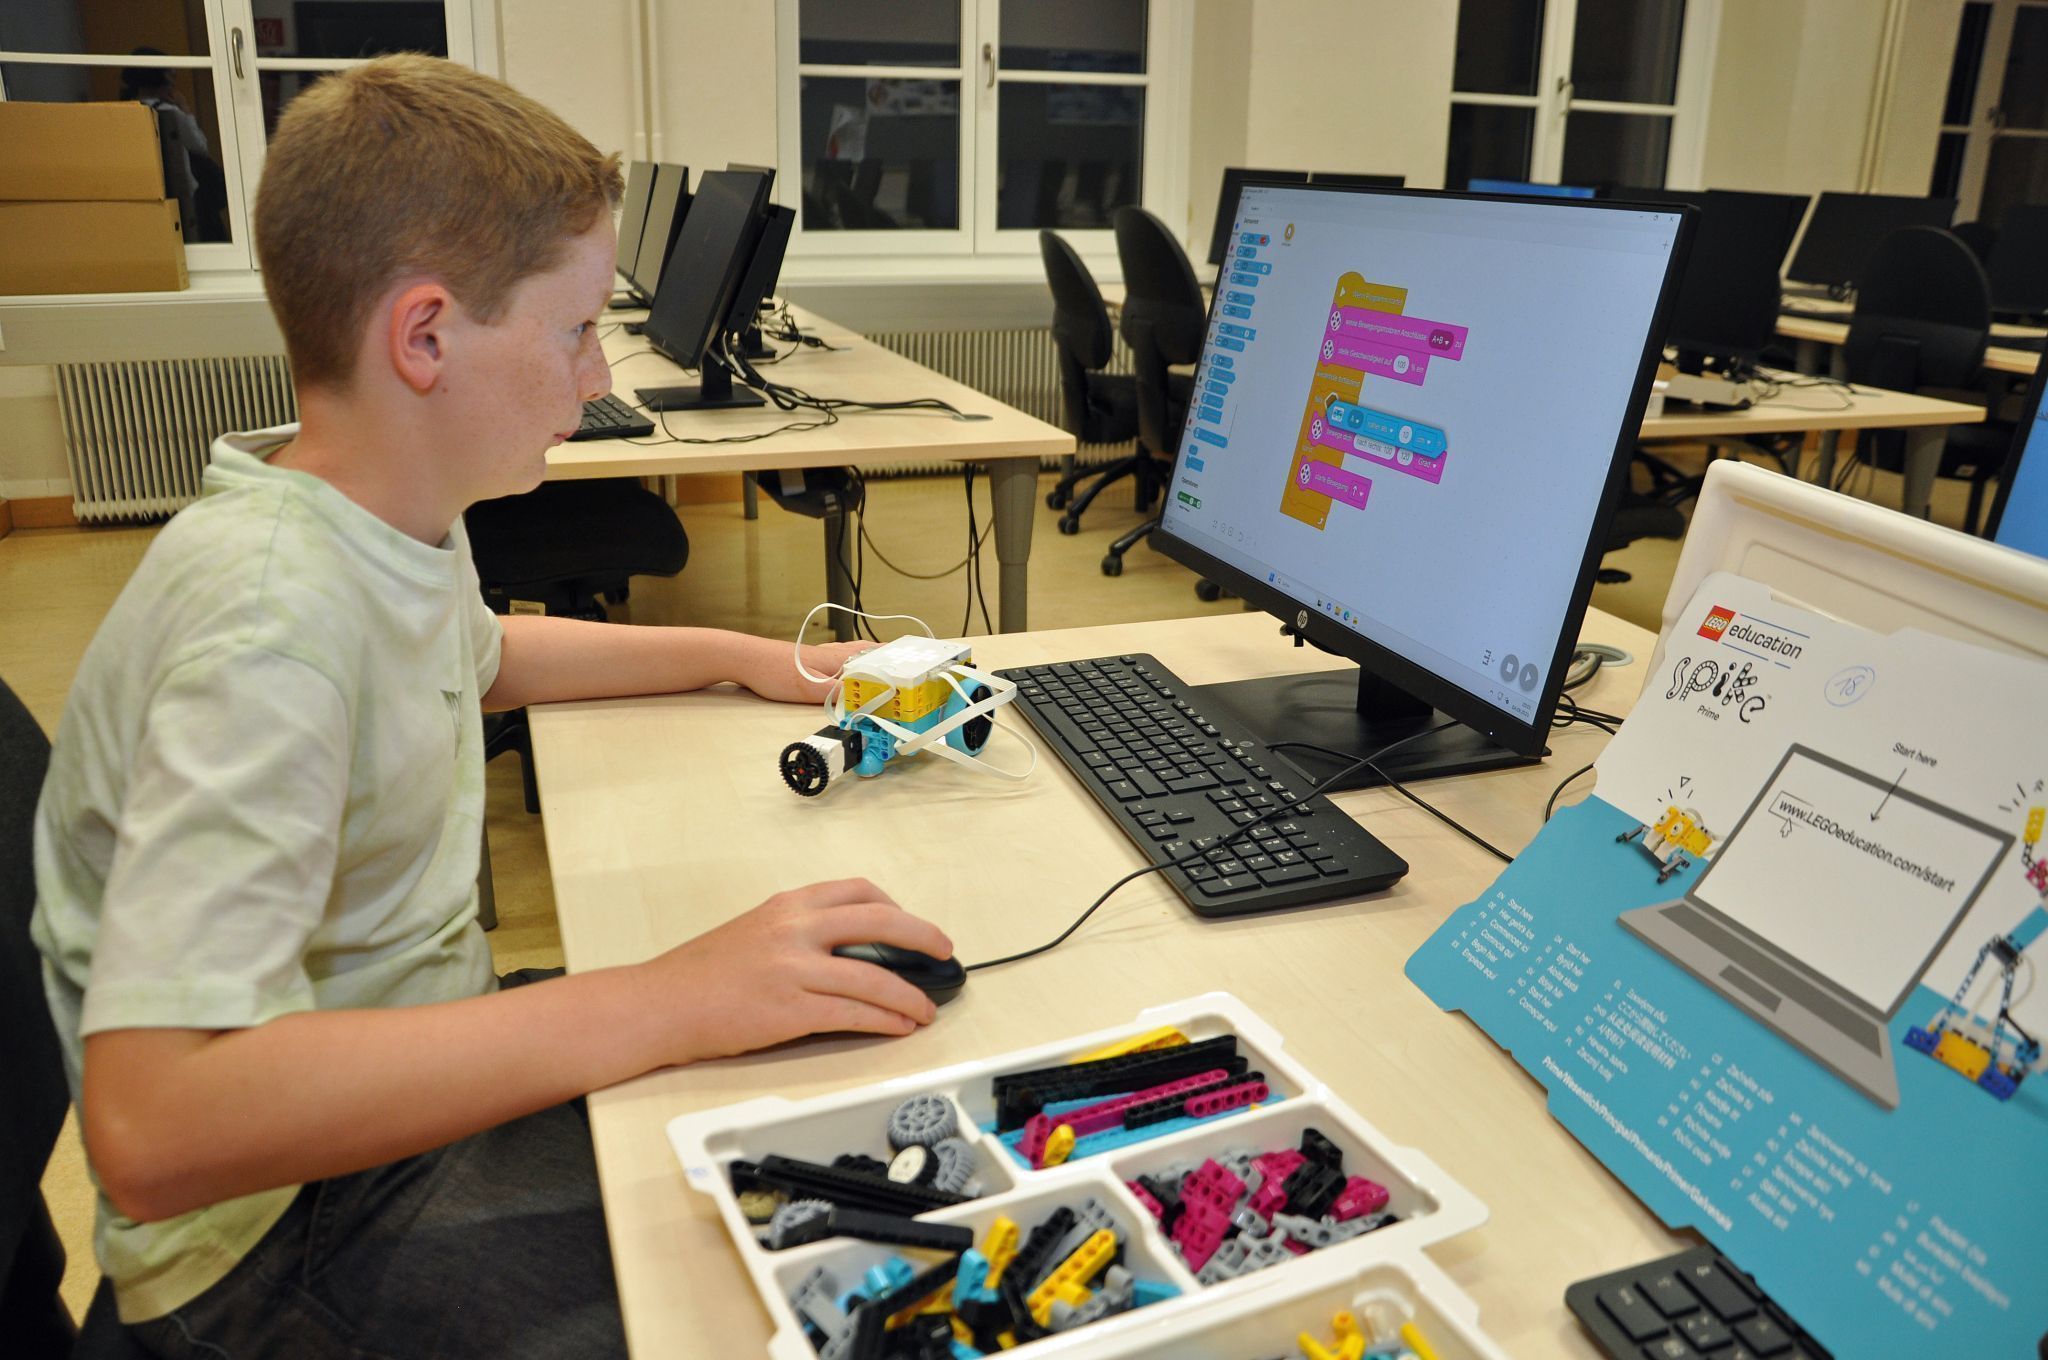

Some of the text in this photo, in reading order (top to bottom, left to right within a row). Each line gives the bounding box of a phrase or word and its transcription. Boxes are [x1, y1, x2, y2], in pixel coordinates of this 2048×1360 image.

[1432, 335, 1444, 344] A+B
[1704, 614, 1802, 659] LEGO education
[1697, 704, 1720, 720] Prime
[1892, 742, 1938, 768] Start here
[1778, 800, 1956, 892] www.LEGOeducation.com/start
